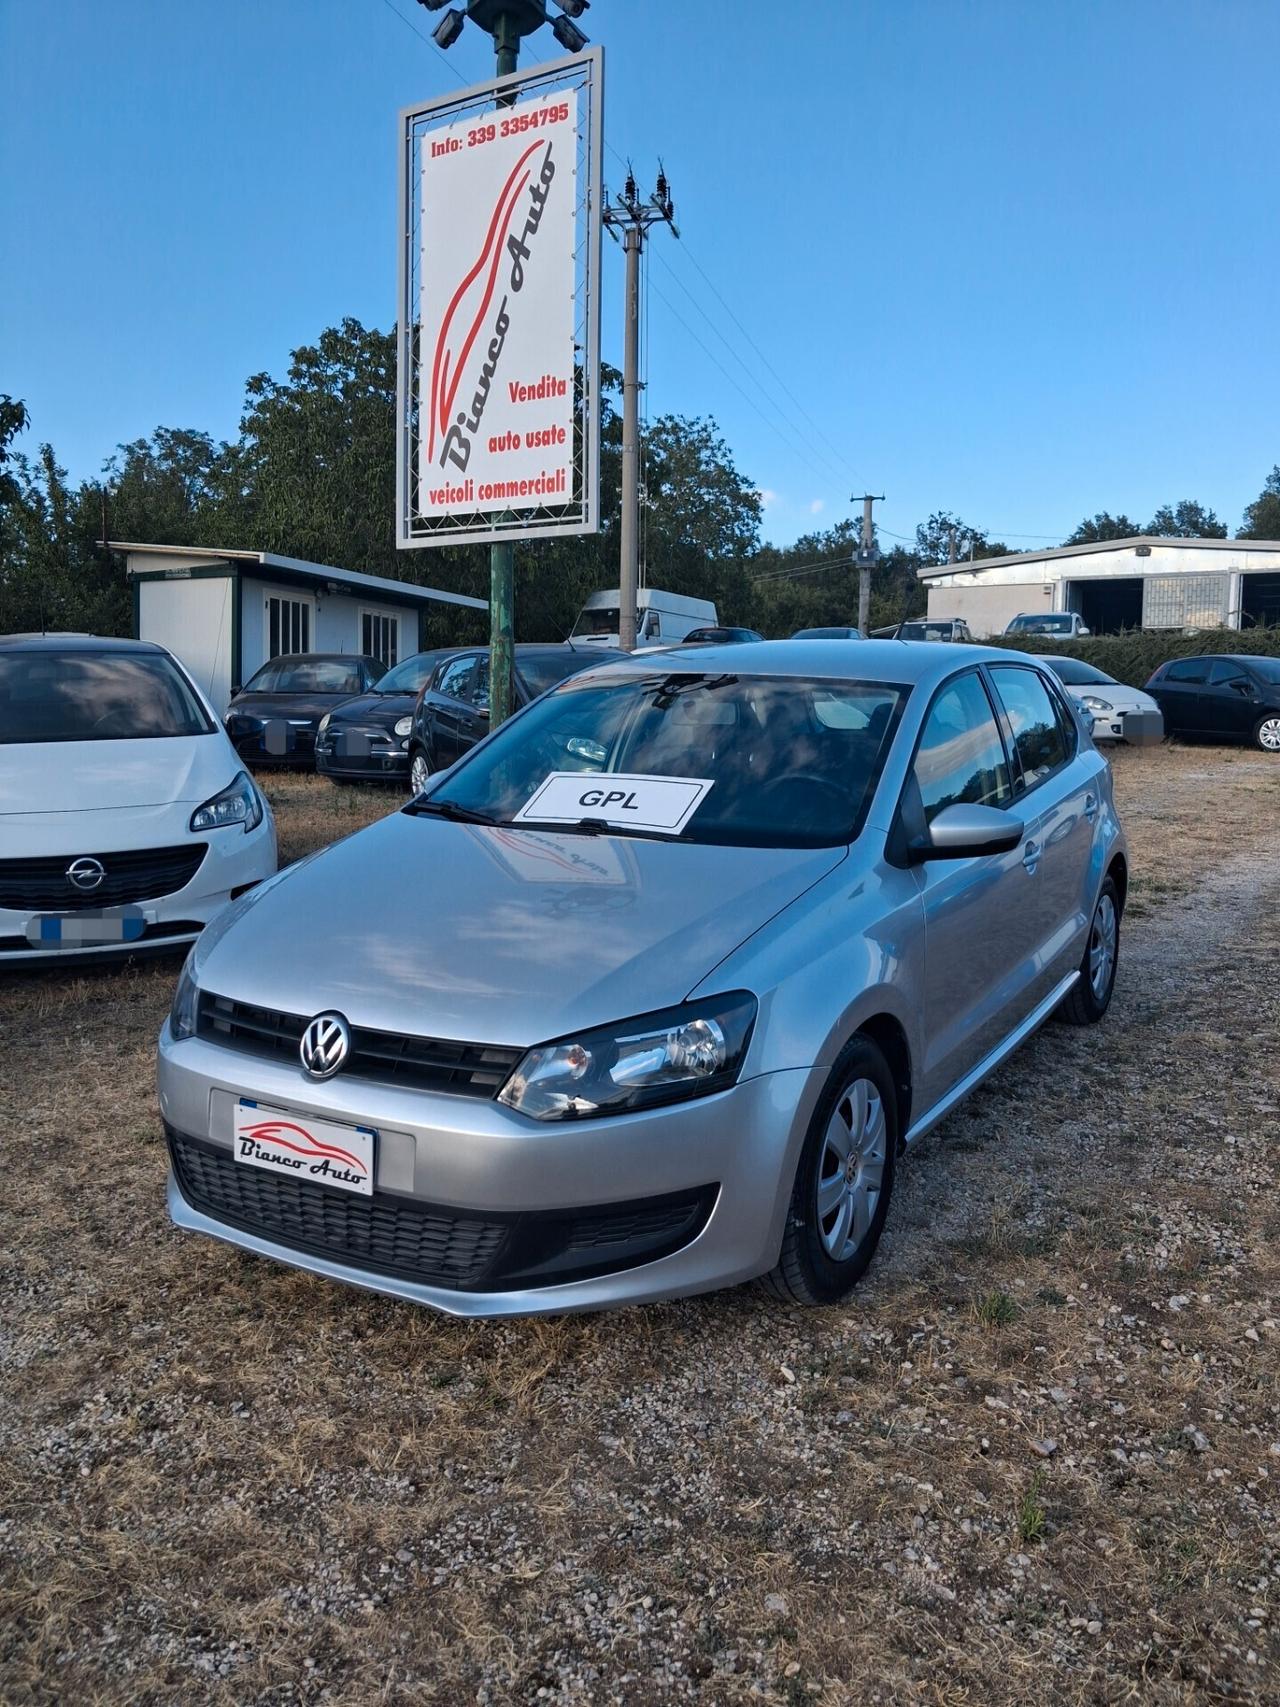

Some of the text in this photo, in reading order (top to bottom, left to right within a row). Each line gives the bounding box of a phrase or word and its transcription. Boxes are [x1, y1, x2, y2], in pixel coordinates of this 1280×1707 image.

[431, 103, 569, 158] Info: 339 3354795
[439, 140, 556, 473] Bianco Auto
[509, 375, 566, 403] Vendita
[488, 424, 566, 453] auto usate
[429, 468, 566, 505] veicoli commerciali
[578, 790, 639, 810] GPL
[239, 1136, 367, 1184] Bianco Auto
